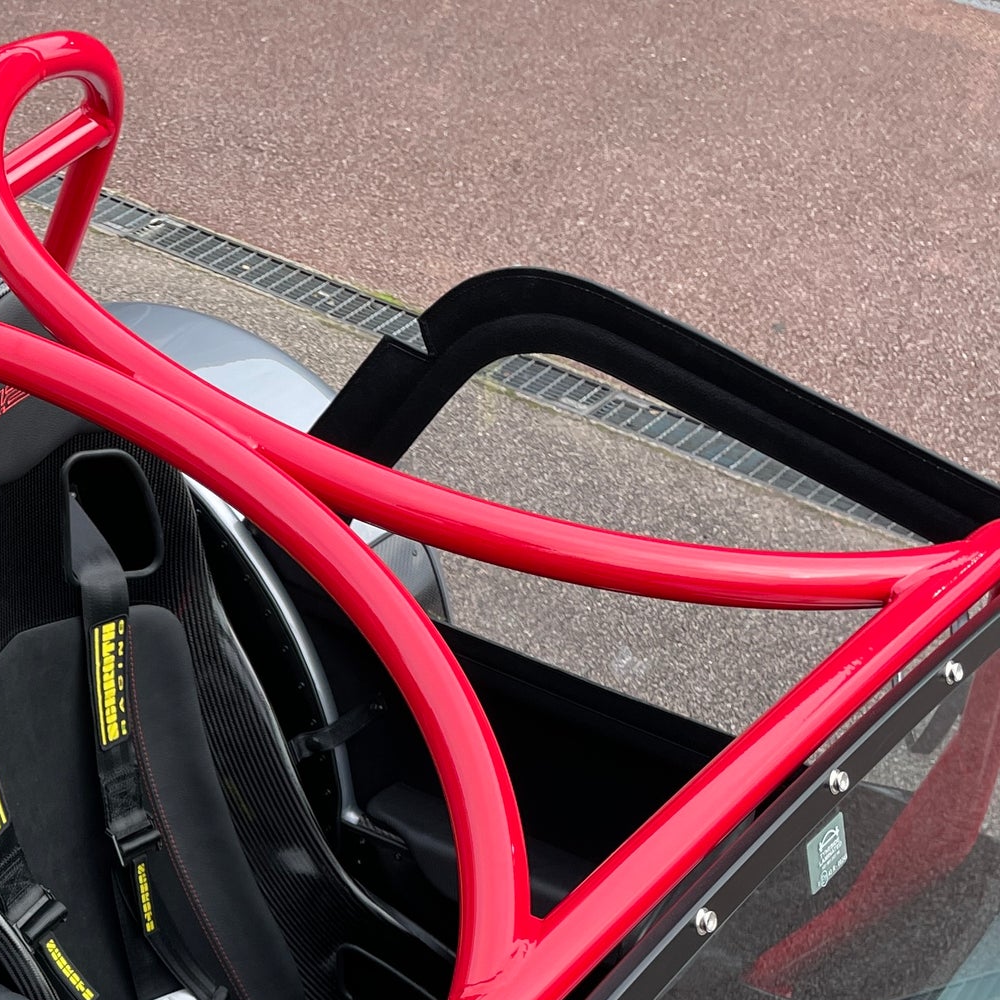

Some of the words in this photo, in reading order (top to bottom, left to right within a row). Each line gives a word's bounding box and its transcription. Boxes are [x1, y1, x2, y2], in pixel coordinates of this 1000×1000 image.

[101, 621, 120, 742] SCHROTH
[117, 618, 128, 736] RACING
[137, 862, 156, 933] SCHROTH
